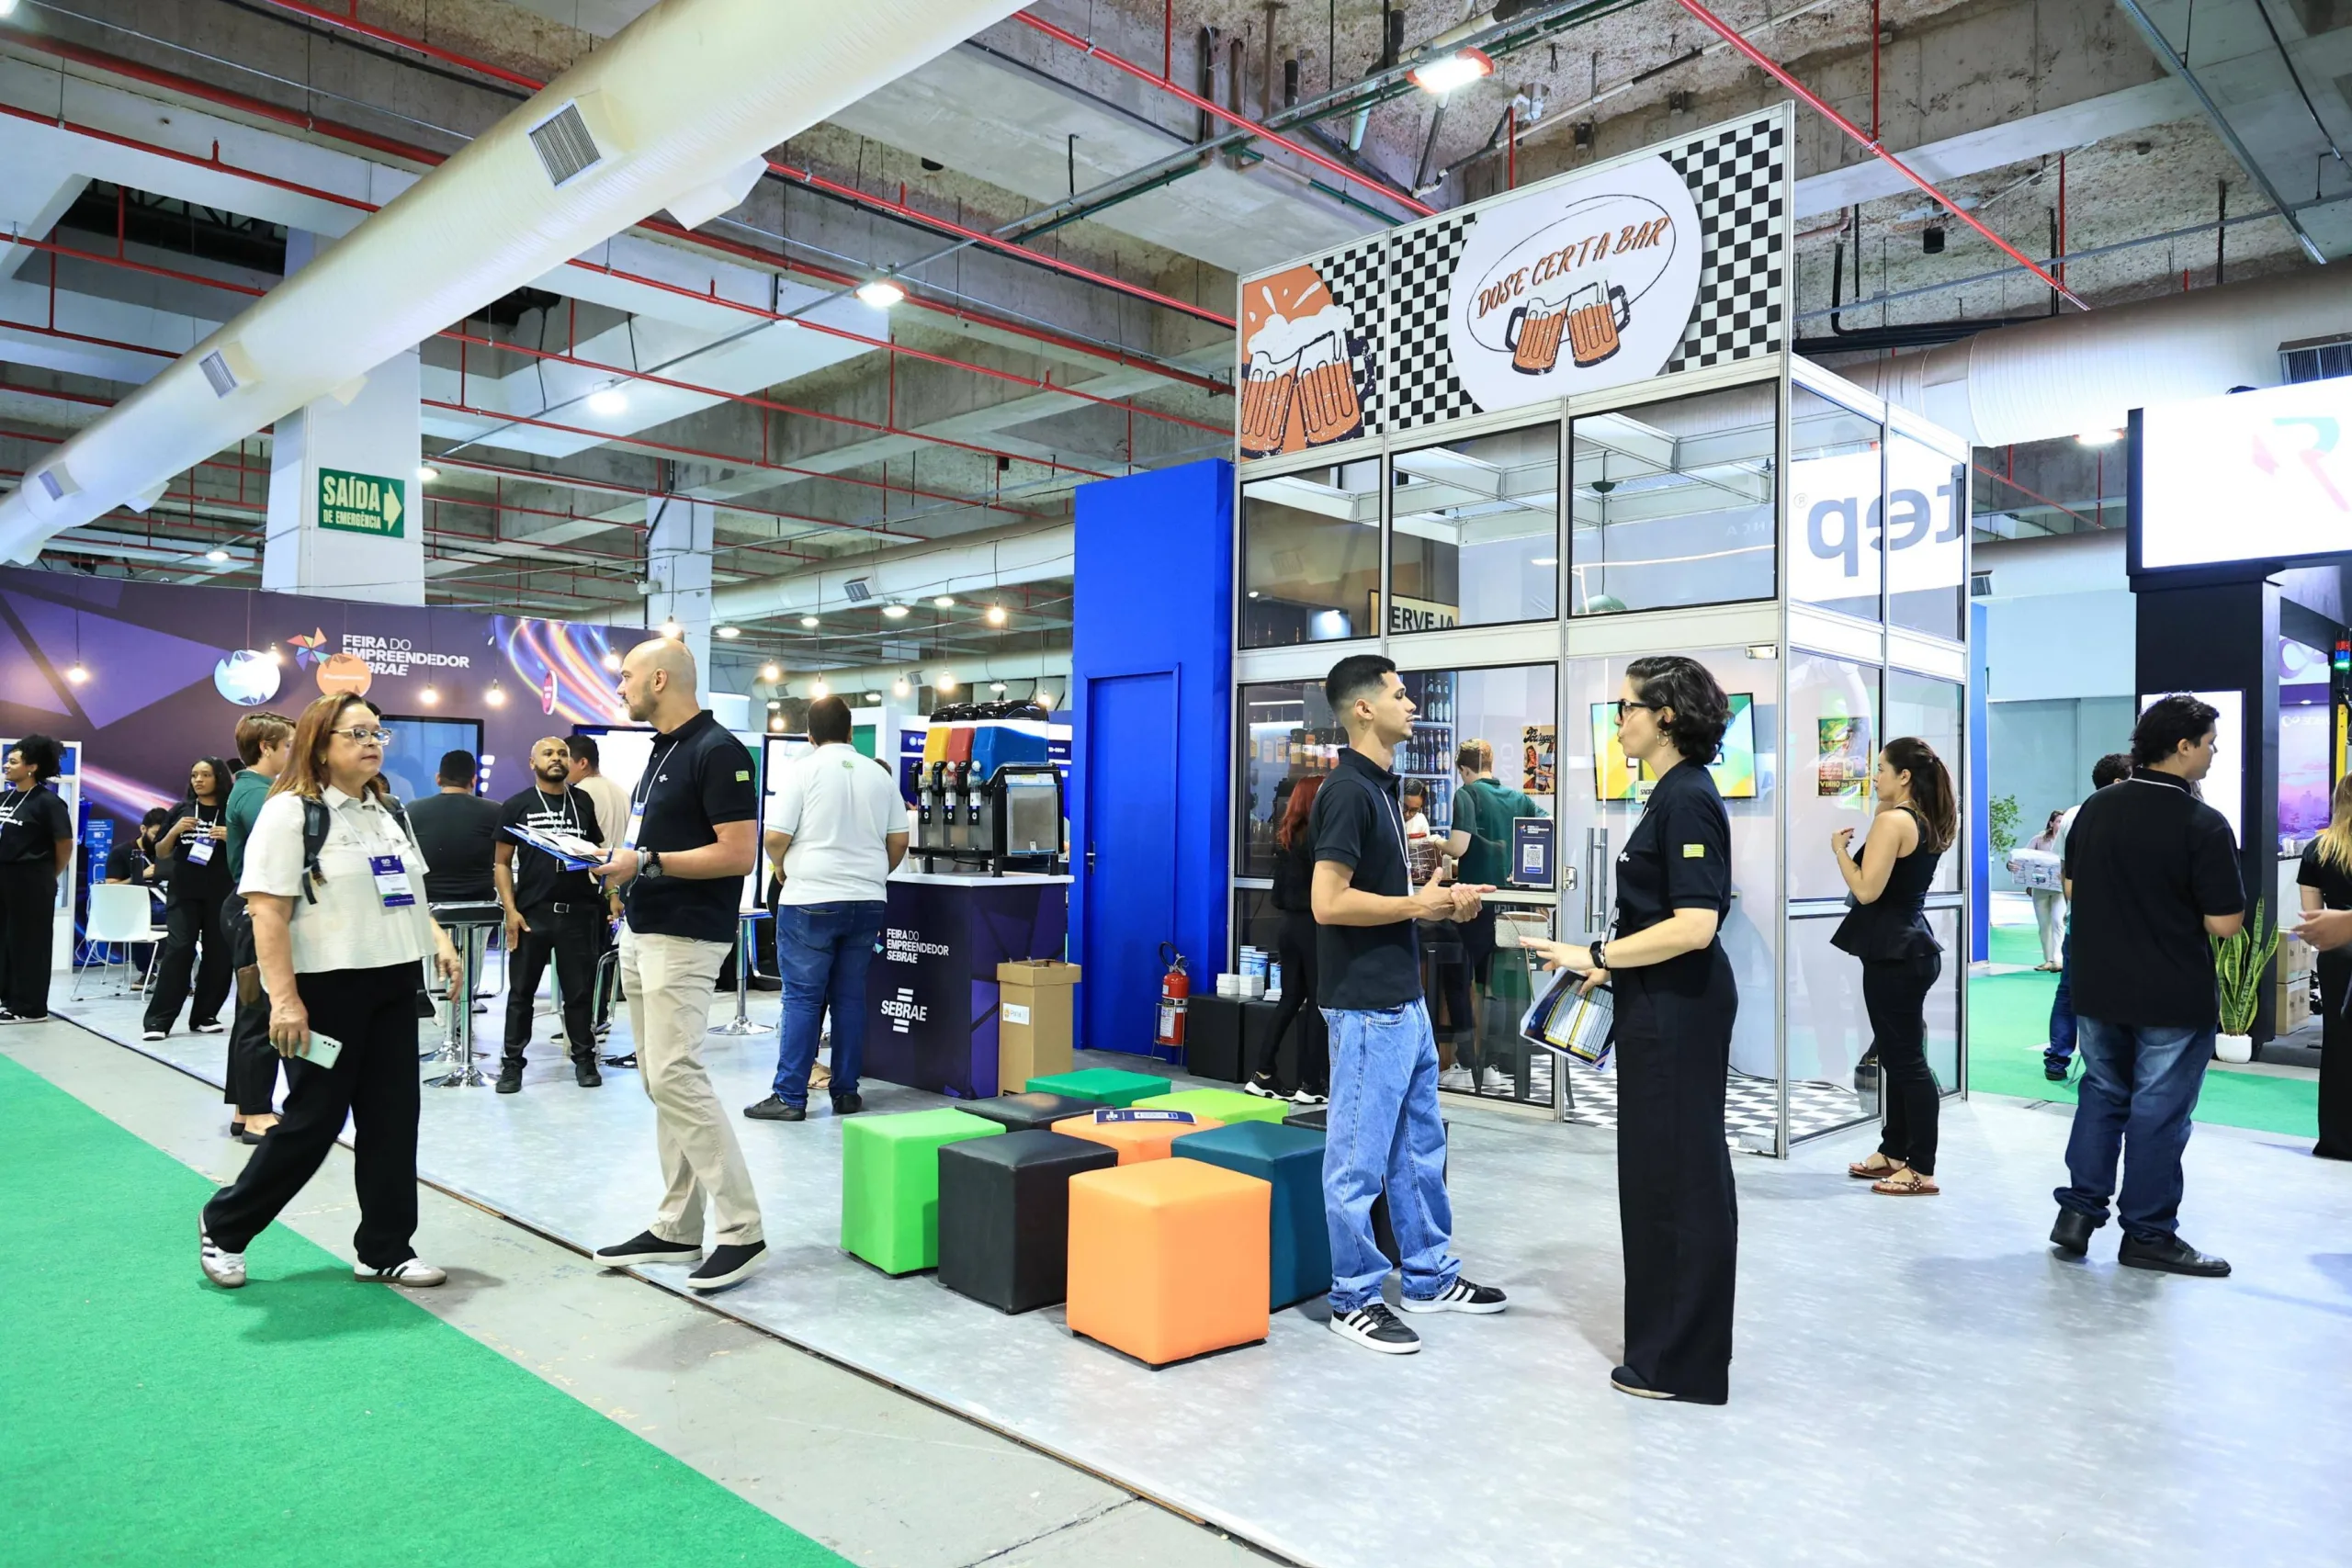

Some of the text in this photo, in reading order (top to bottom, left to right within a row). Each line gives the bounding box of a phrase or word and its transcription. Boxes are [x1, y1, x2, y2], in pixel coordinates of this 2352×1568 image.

[1476, 266, 1529, 319] DOSE
[1612, 217, 1669, 254] BAR
[322, 475, 380, 512] SAÍDA
[322, 509, 381, 530] DE EMERGÊNCIA
[1391, 605, 1454, 631] ERVEJA
[343, 634, 412, 650] FEIRA DO
[343, 647, 469, 668] EMPREENDEDOR
[367, 660, 409, 676] BRAE
[887, 928, 920, 941] FEIRA DO
[887, 939, 949, 956] EMPREENDEDOR
[887, 950, 919, 964] SEBRAE
[880, 999, 928, 1021] SEBRAE
